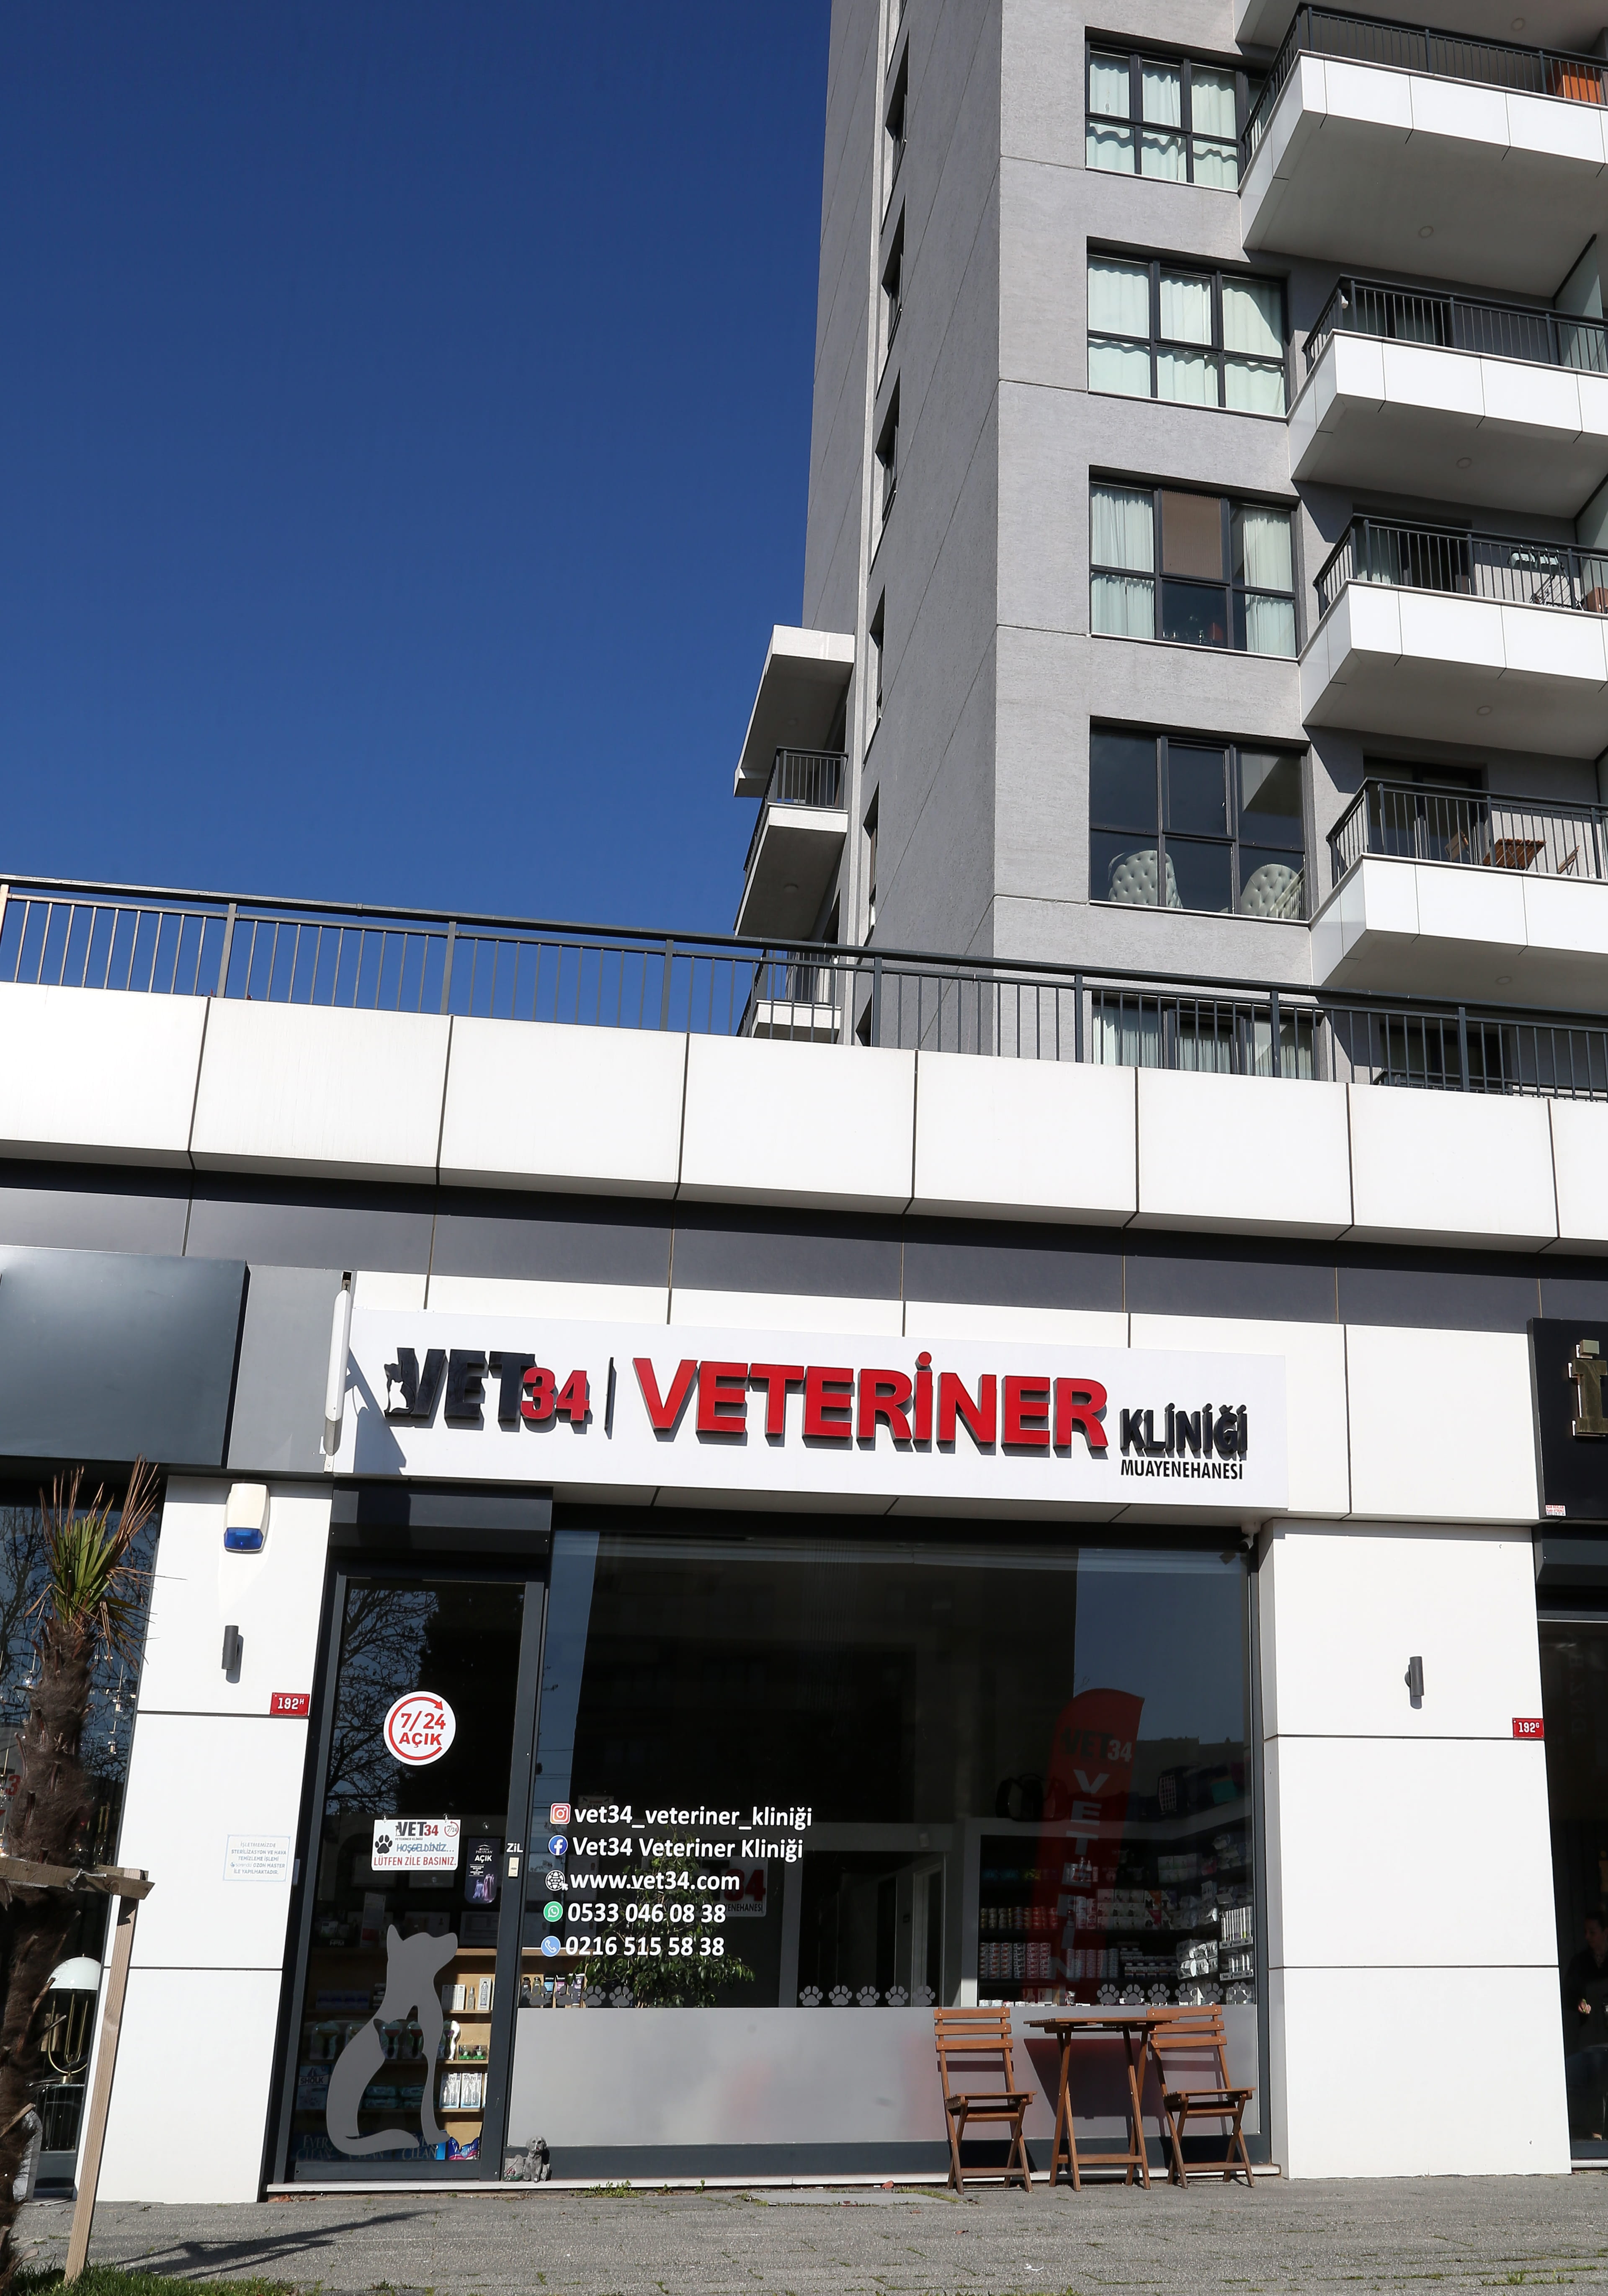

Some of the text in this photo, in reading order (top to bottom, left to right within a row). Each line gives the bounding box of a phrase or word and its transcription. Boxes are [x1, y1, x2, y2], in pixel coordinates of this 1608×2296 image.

[386, 1347, 1248, 1455] VET34 VETERİNER KLİNİĞİ
[1121, 1459, 1243, 1480] MUAYENEHANESİ
[400, 1712, 446, 1732] 7/24
[399, 1733, 442, 1748] AÇIK
[574, 1805, 812, 1831] vet34_veteriner_kliniği
[395, 1821, 439, 1837] VET34
[474, 1855, 492, 1863] AÇIK
[573, 1837, 804, 1863] Vet34 Veteriner Kliniği
[374, 1855, 456, 1866] LÜTFEN ZİLE BASINIZ.
[570, 1871, 740, 1891] www.vet34.com
[567, 1903, 619, 1922] 0533
[625, 1904, 664, 1922] 046
[670, 1904, 695, 1923] 08
[701, 1904, 726, 1923] 38
[565, 1936, 725, 1956] 0216 515 58 38
